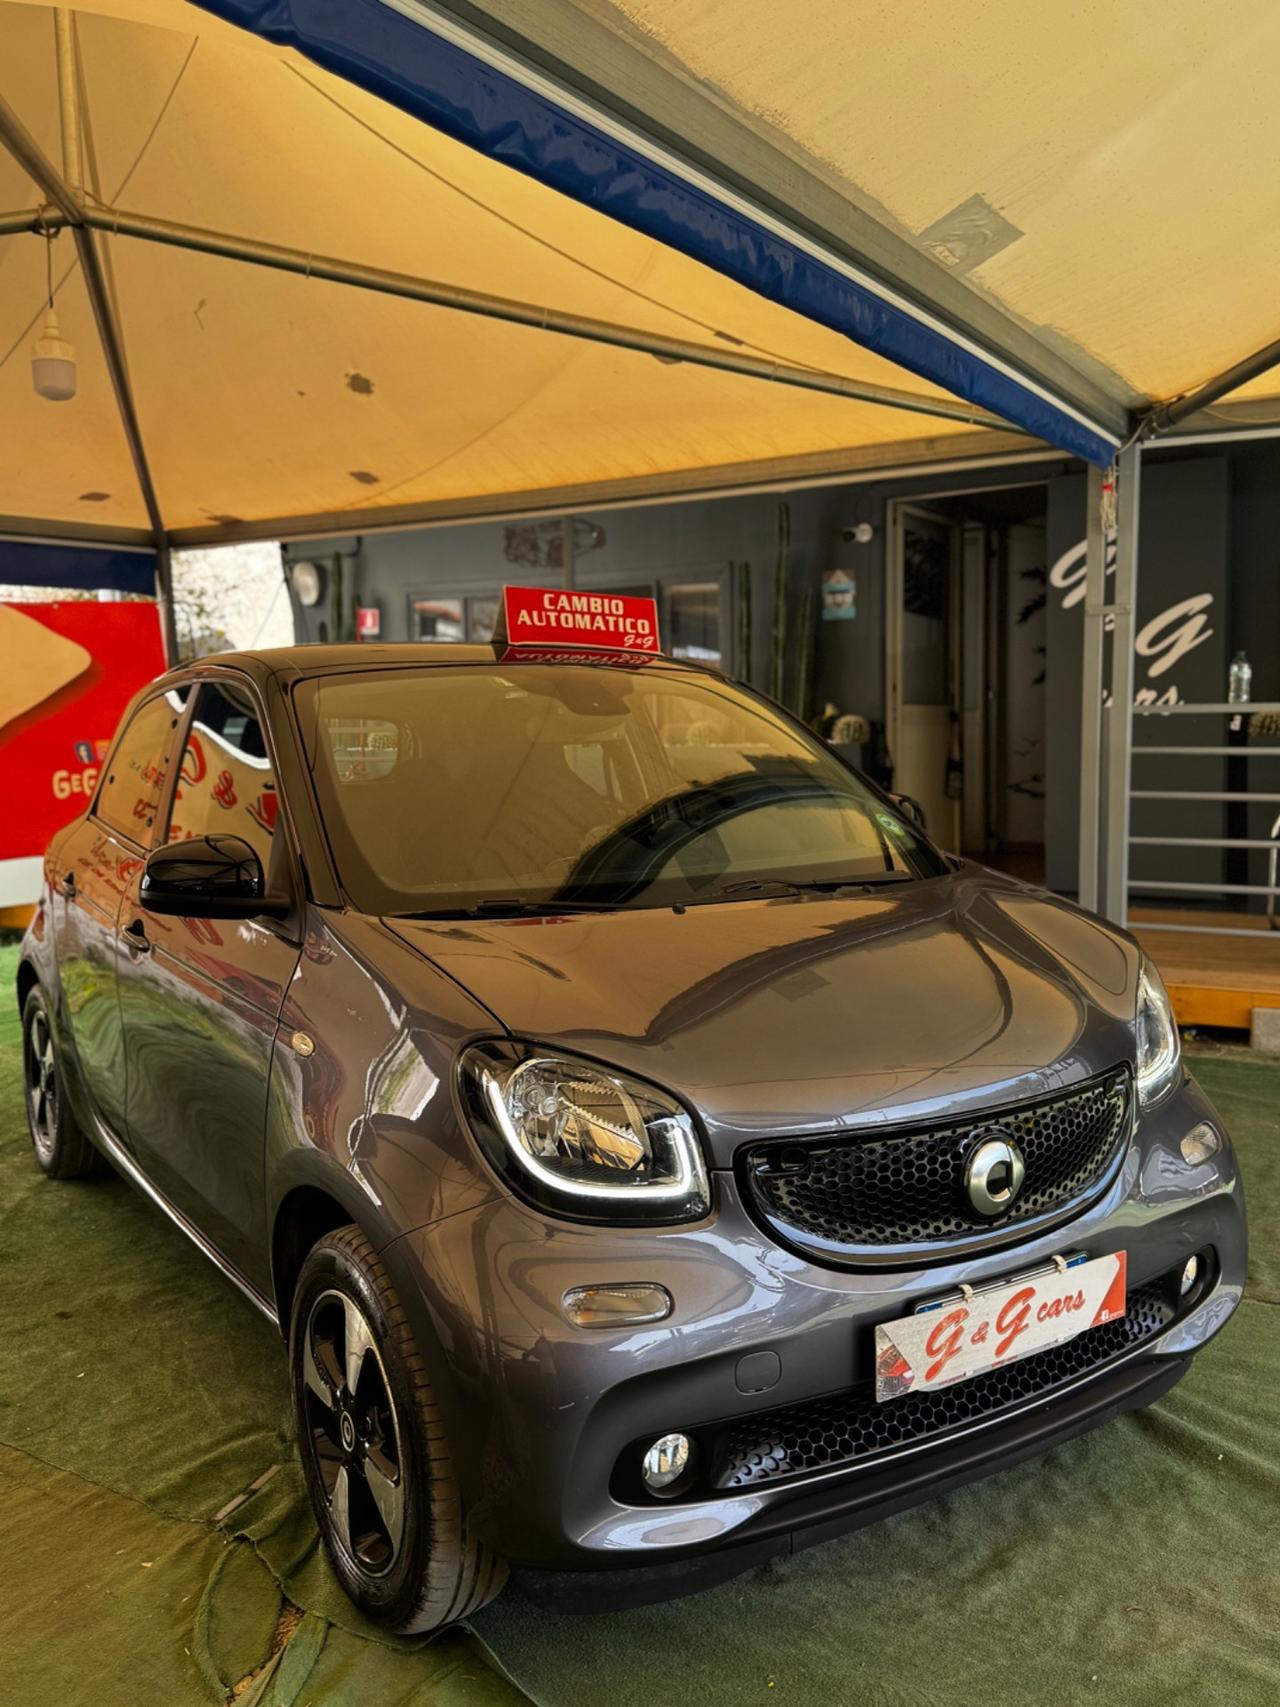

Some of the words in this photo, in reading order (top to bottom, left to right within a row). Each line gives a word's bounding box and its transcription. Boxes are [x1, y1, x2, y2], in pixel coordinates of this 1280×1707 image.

[543, 593, 625, 616] CAMBIO
[517, 609, 651, 635] AUTOMATICO
[925, 1307, 969, 1382] G
[970, 1321, 990, 1345] &
[994, 1286, 1036, 1358] G
[1036, 1289, 1086, 1324] cars
